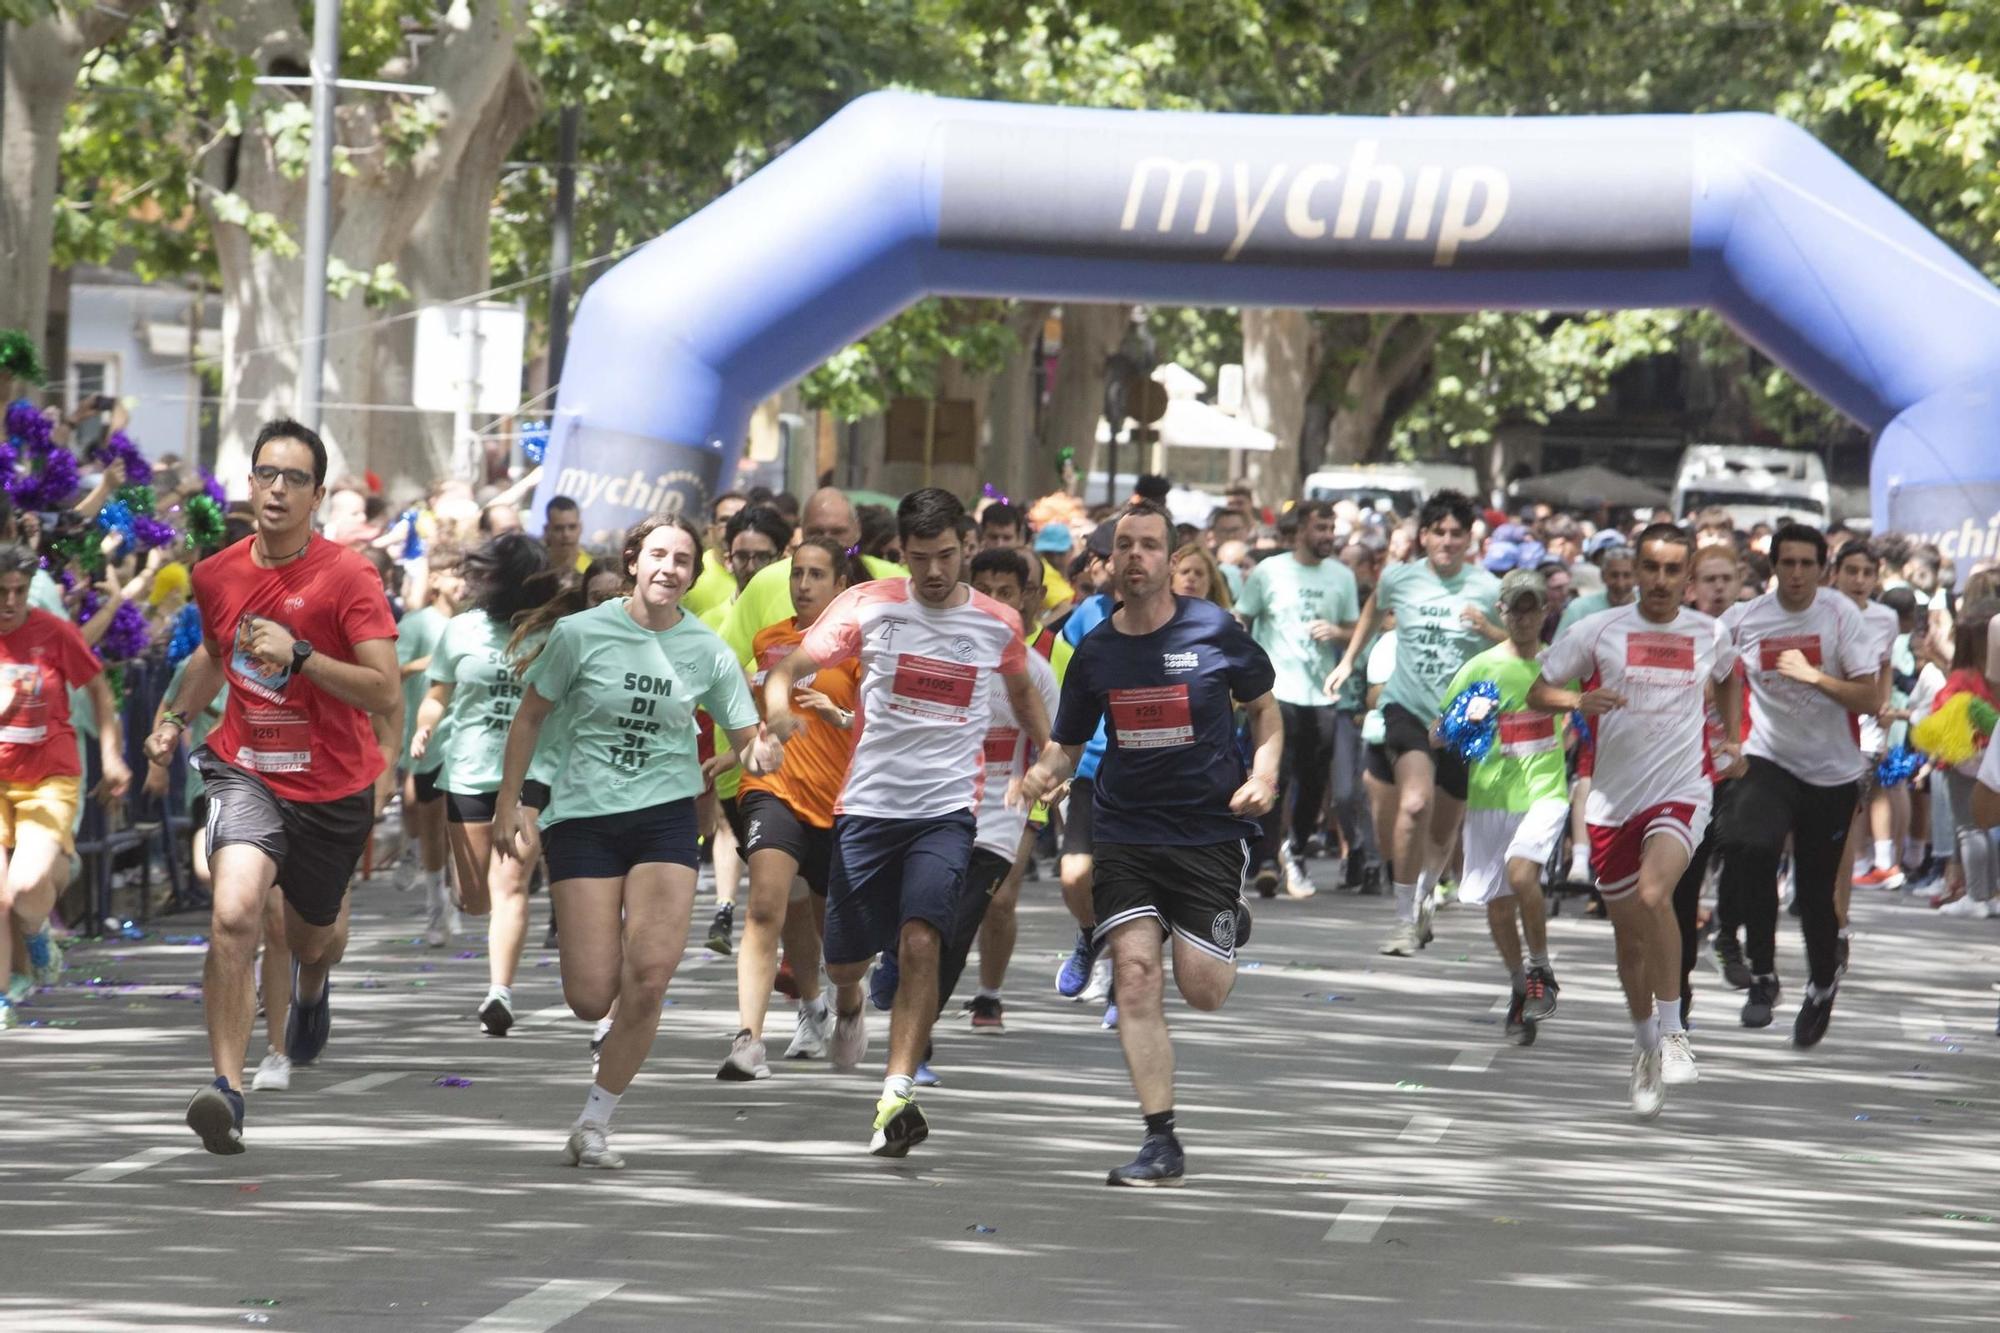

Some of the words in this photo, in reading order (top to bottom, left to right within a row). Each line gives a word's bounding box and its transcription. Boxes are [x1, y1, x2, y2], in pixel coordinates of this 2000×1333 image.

[1120, 139, 1511, 267] mychip
[1420, 606, 1451, 617] SOM
[1416, 662, 1446, 675] TAT
[489, 684, 522, 698] VER
[624, 672, 672, 697] SOM
[494, 702, 511, 715] SI
[630, 697, 656, 716] DI
[617, 716, 660, 735] VER
[623, 733, 645, 750] SI
[609, 746, 650, 769] TAT
